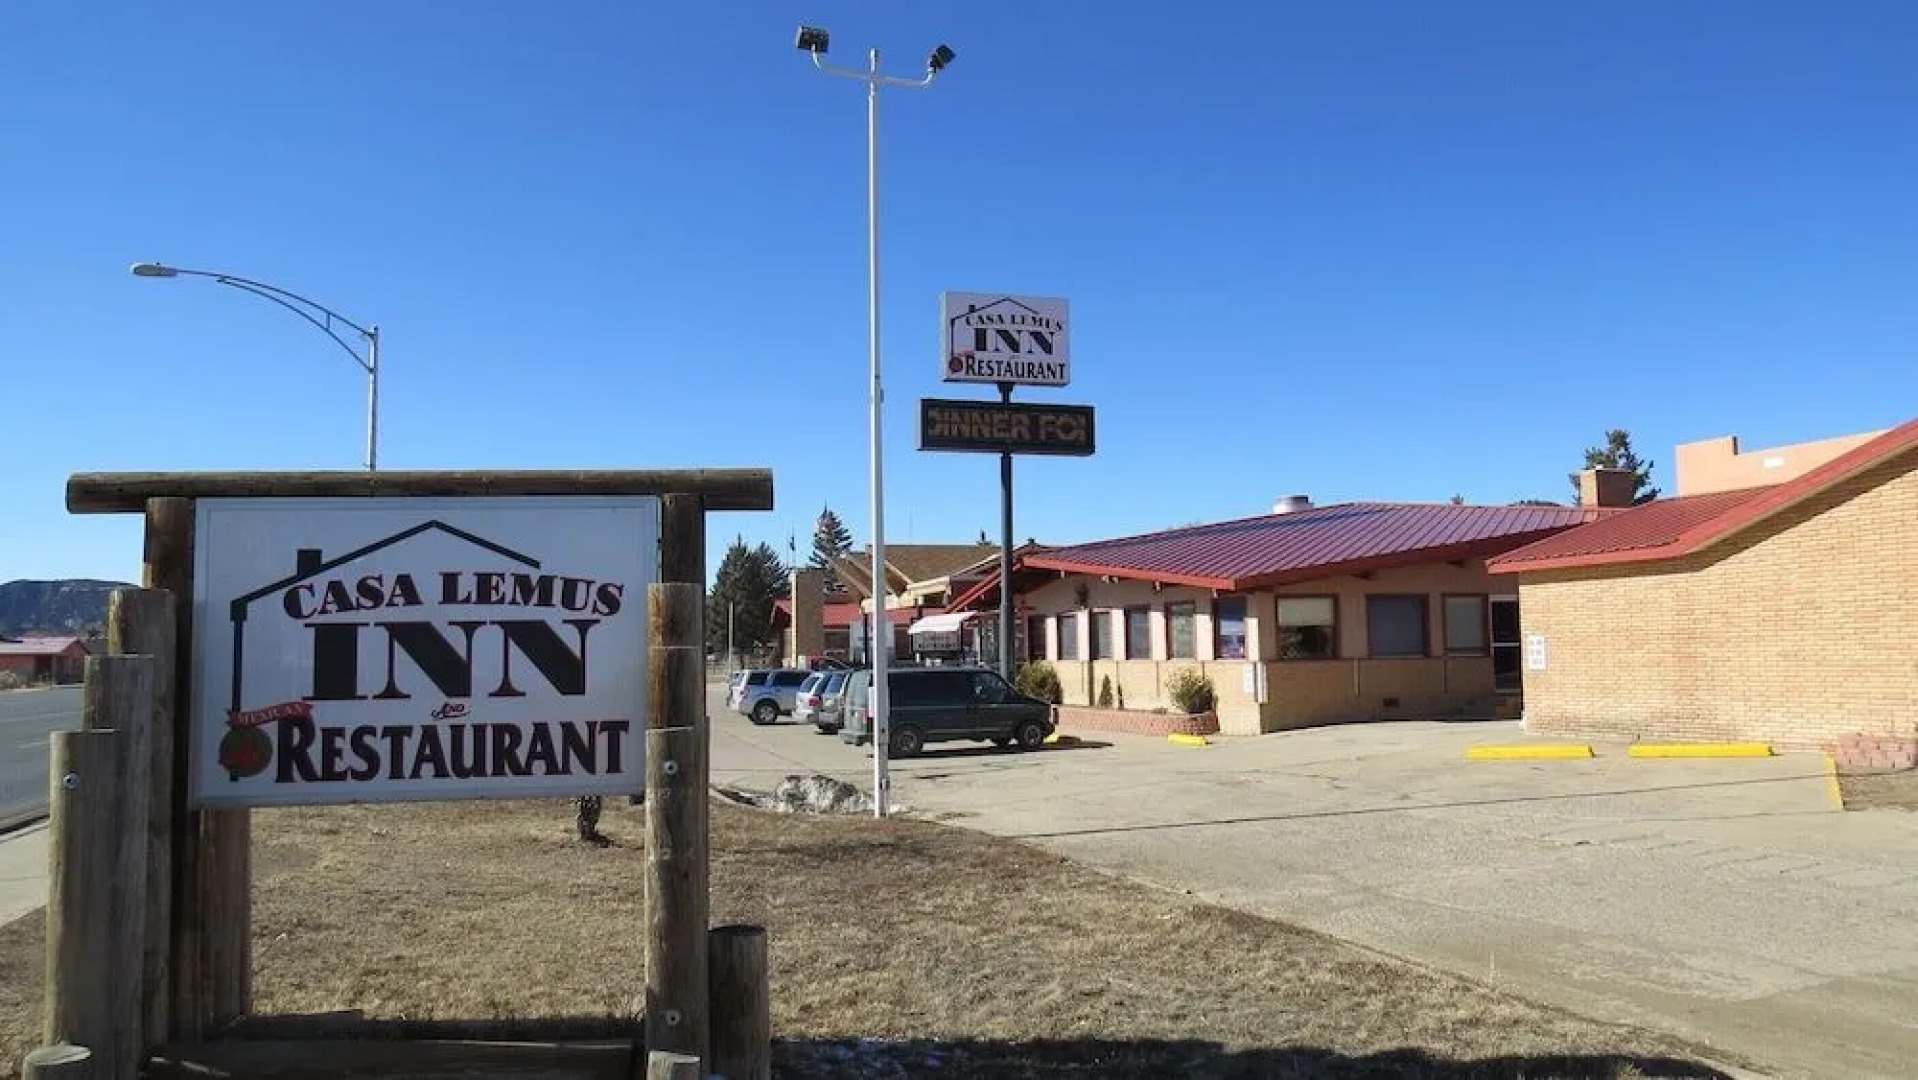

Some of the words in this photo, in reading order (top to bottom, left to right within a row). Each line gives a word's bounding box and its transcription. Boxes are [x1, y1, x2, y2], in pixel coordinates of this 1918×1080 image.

[965, 313, 1005, 327] CASA
[1011, 314, 1062, 331] LEMUS
[974, 327, 1055, 356] INN
[965, 354, 1066, 380] RESTAURANT
[283, 573, 423, 620] CASA
[439, 571, 625, 617] LEMUS
[302, 619, 600, 699] INN
[275, 720, 630, 783] RESTAURANT
